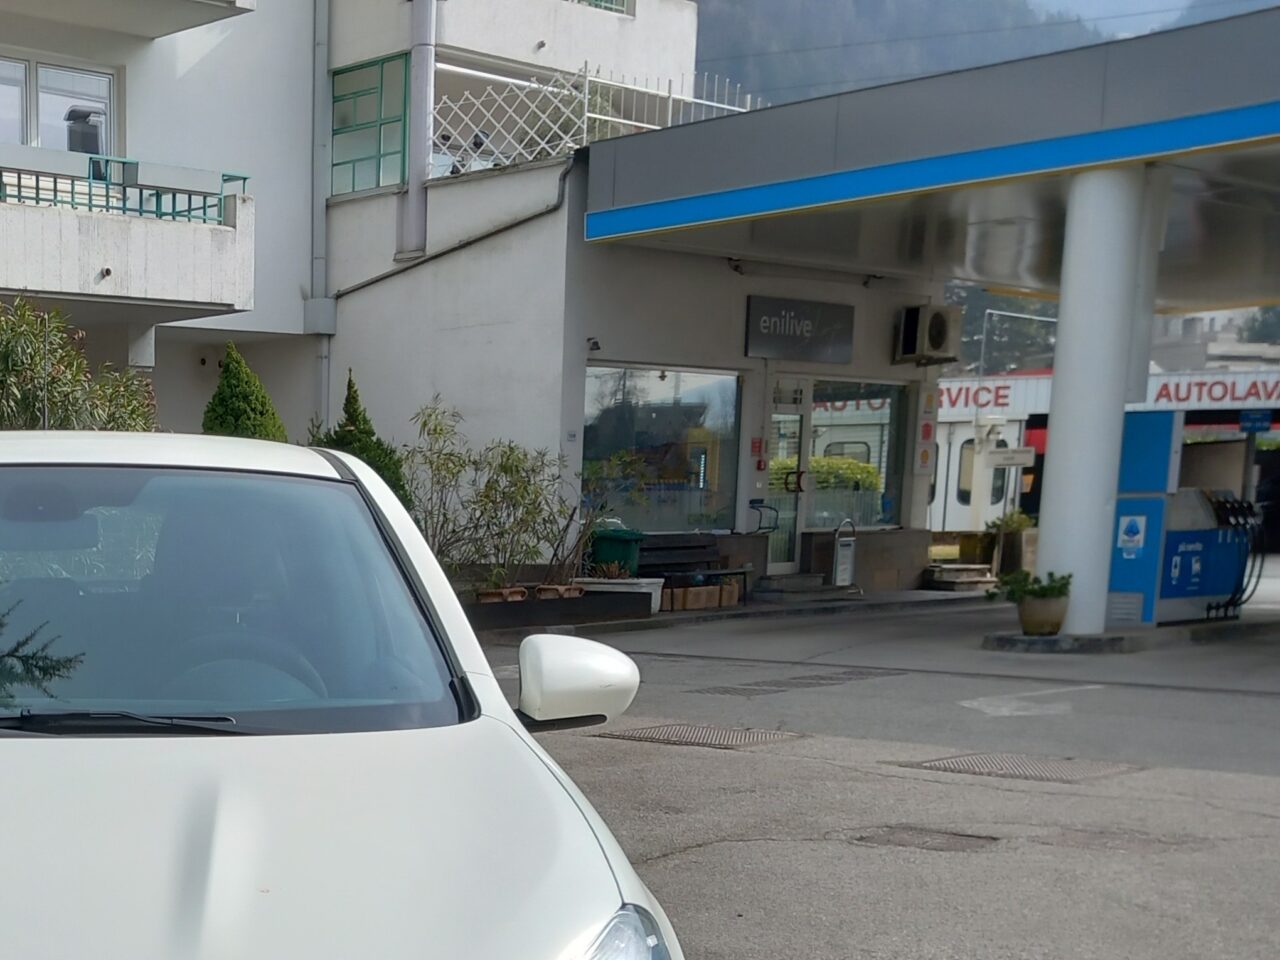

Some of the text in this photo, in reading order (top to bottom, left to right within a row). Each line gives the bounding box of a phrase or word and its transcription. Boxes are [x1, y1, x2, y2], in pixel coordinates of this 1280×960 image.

[760, 311, 813, 337] enilive
[937, 385, 1011, 409] RVICE
[1155, 380, 1280, 402] AUTOLAV
